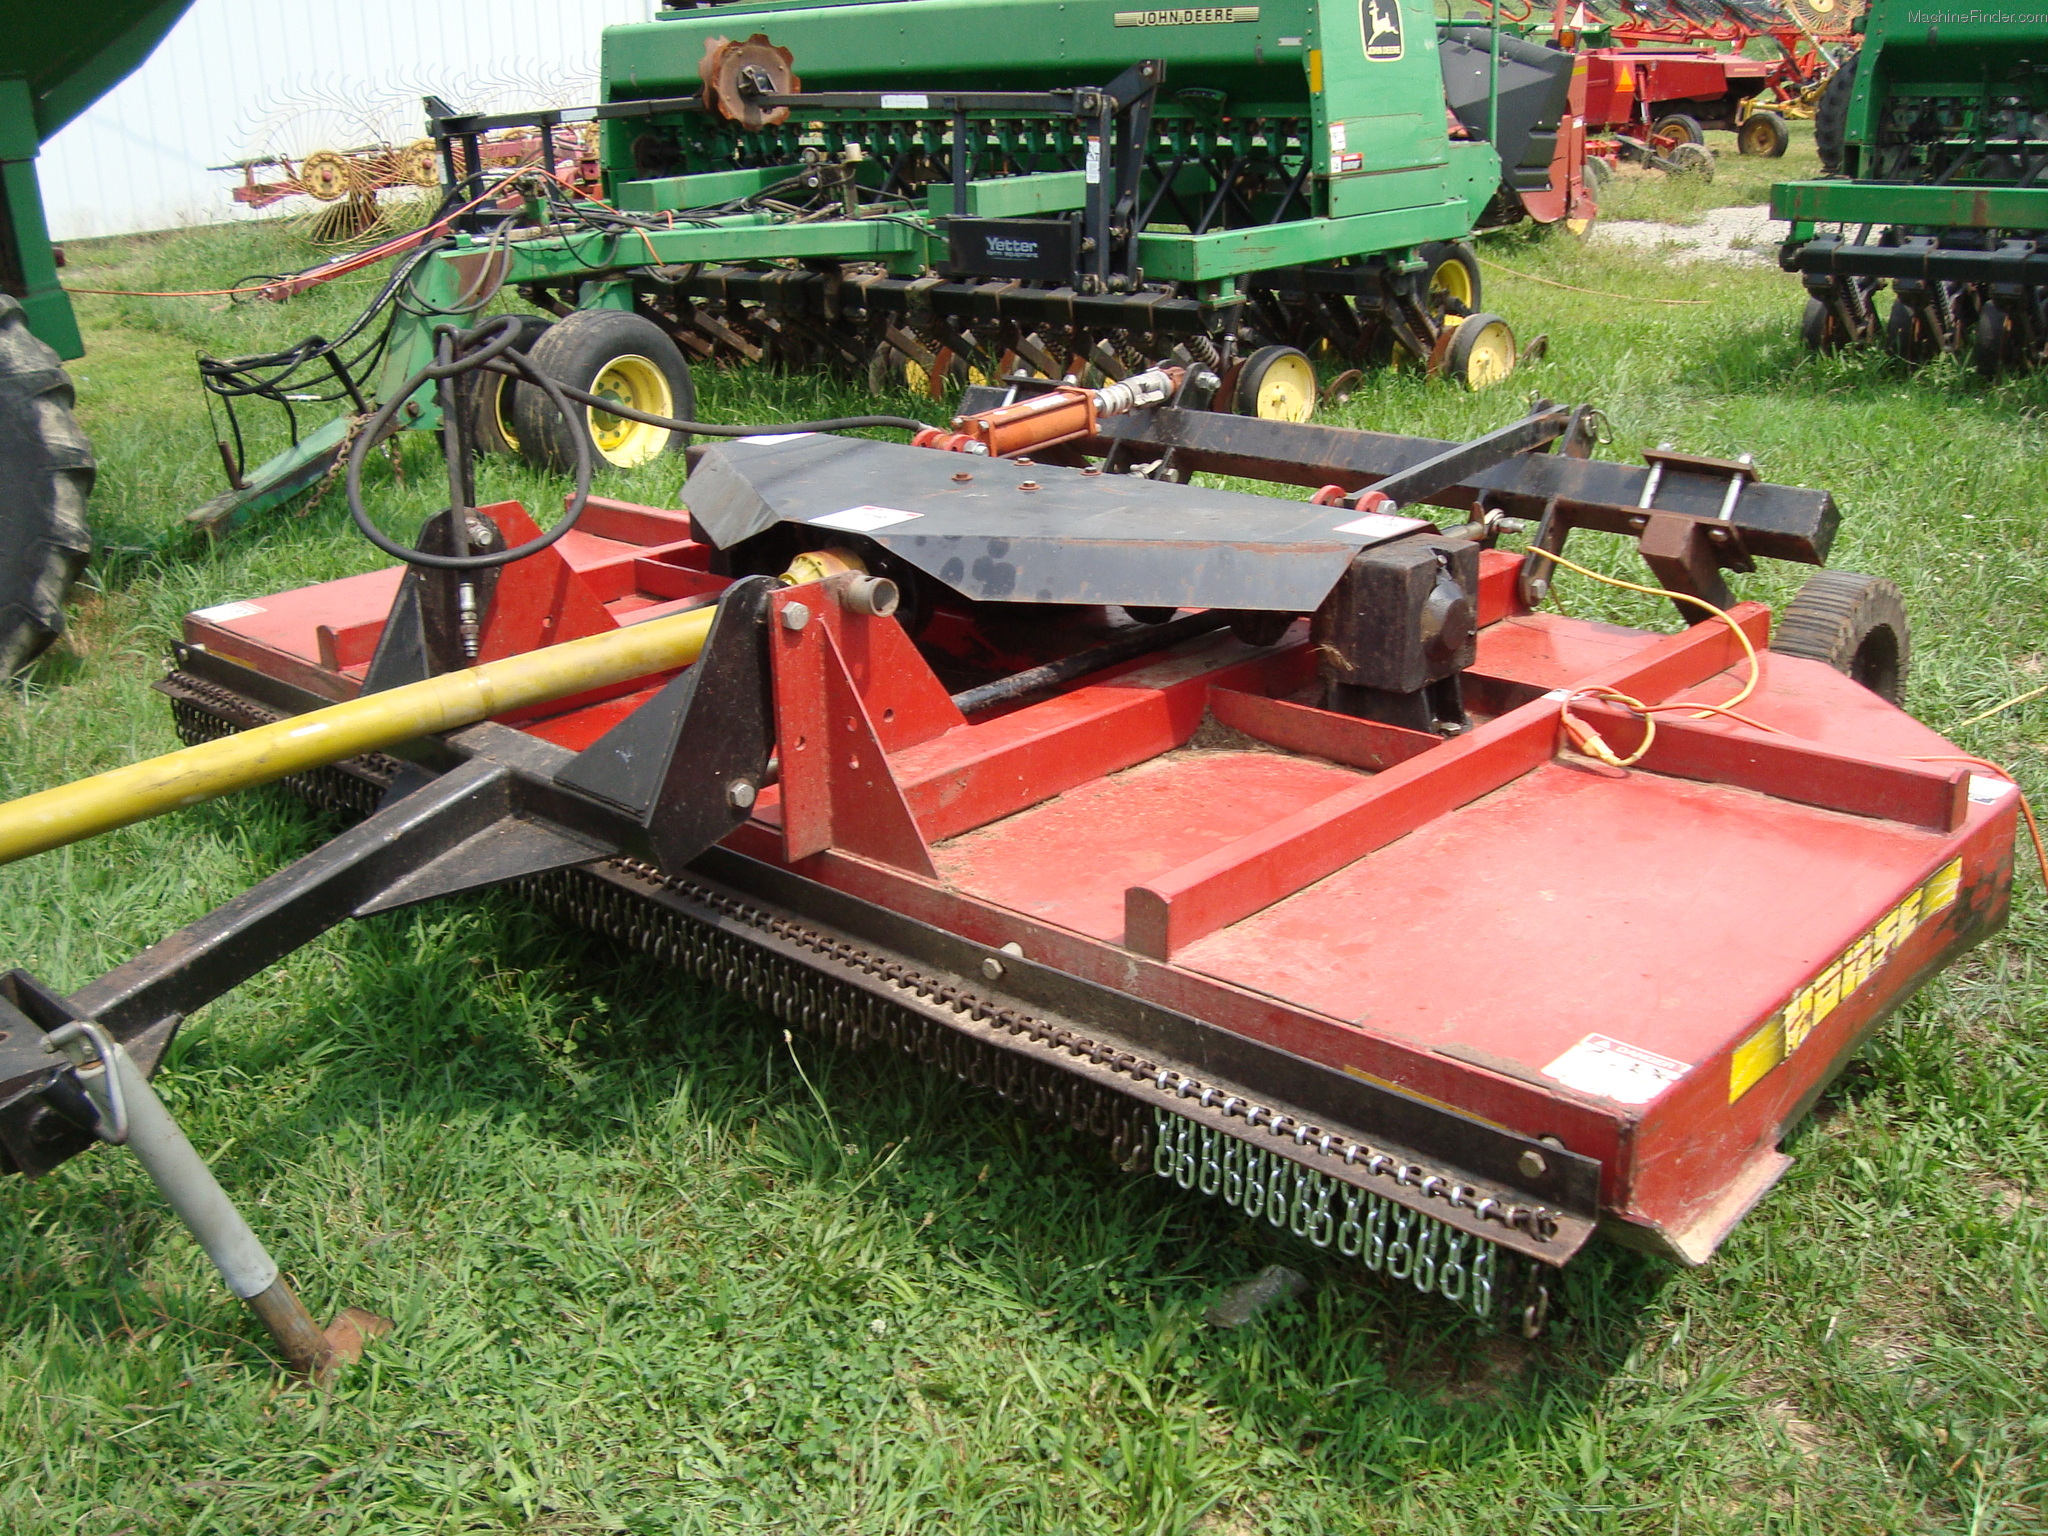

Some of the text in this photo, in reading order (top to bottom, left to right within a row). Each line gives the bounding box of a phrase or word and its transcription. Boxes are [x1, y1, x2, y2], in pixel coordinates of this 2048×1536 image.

[1138, 8, 1234, 26] JOHN DEERE
[985, 236, 1039, 253] Yetter
[1614, 1046, 1676, 1069] DANGER
